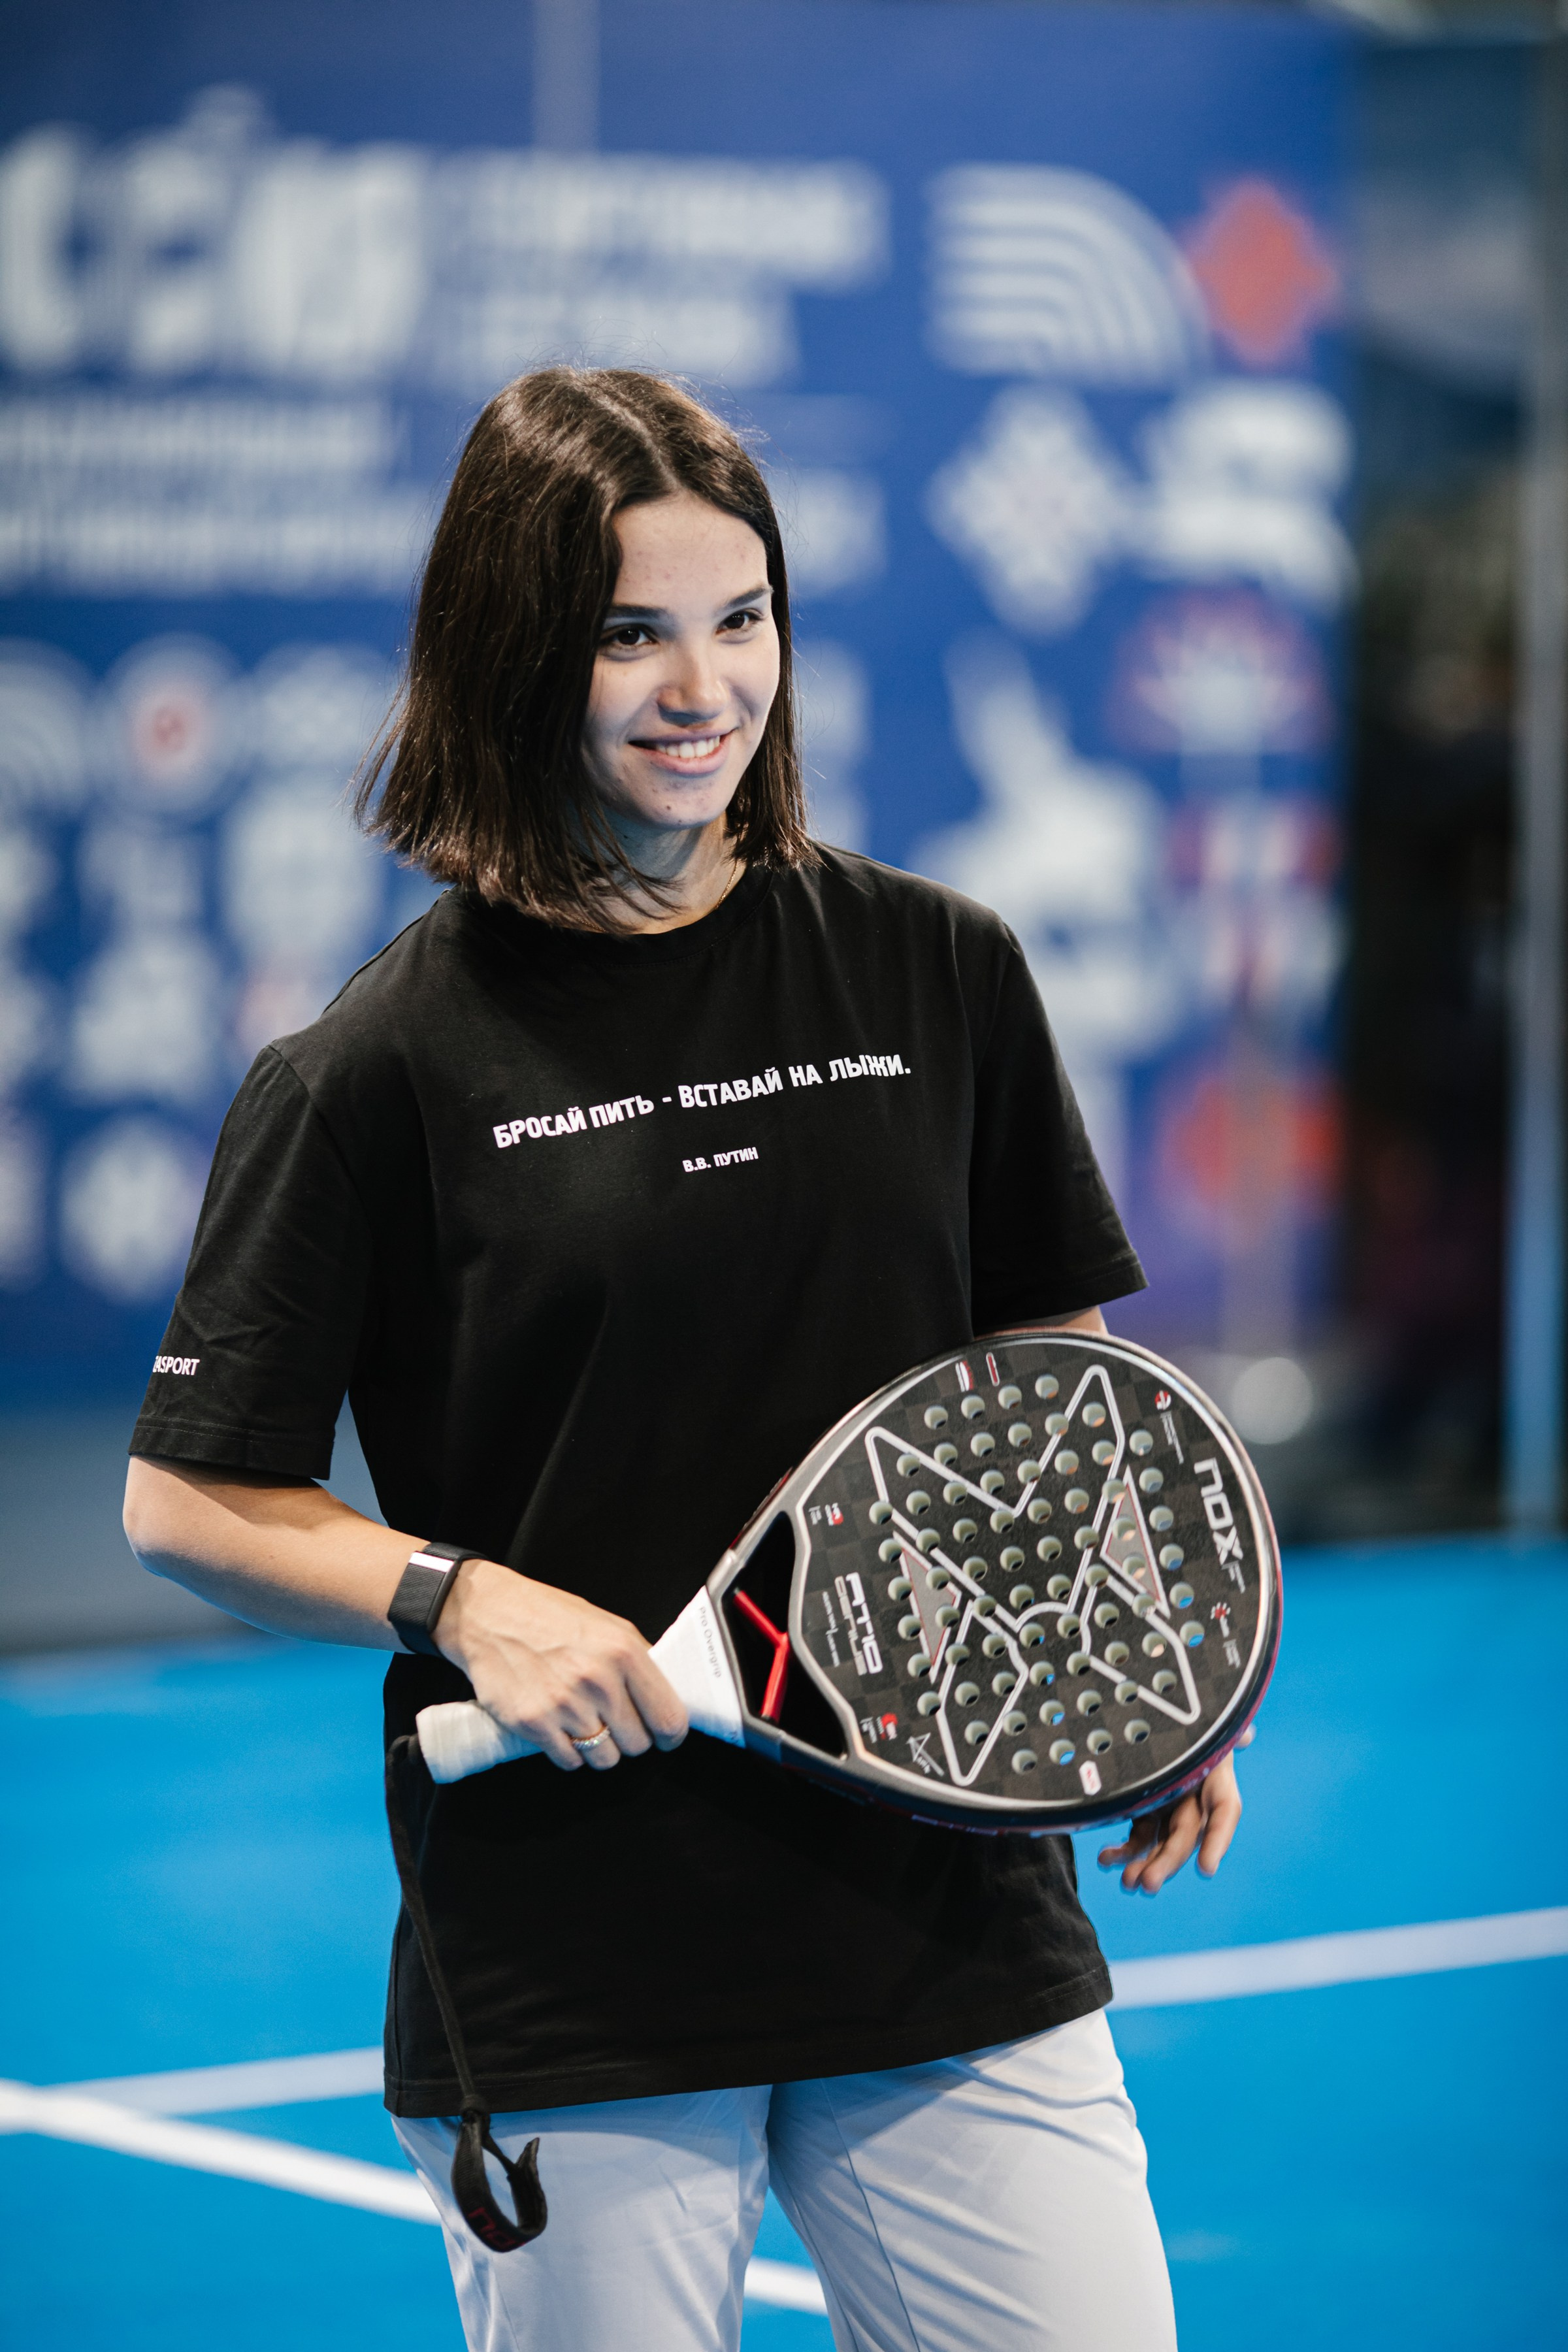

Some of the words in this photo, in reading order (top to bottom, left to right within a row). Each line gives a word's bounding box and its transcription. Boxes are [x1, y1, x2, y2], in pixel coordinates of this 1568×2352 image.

[493, 1107, 587, 1148] БРОСАЙ
[589, 1096, 654, 1128] ПИТЬ
[678, 1067, 783, 1107] ВСТАВАЙ
[789, 1065, 823, 1086] НА
[829, 1054, 911, 1081] ЛЫЖИ.
[683, 1158, 711, 1172] В.В.
[713, 1147, 759, 1166] ПУТИН
[696, 1606, 710, 1627] Pro
[700, 1628, 724, 1678] Overgrip
